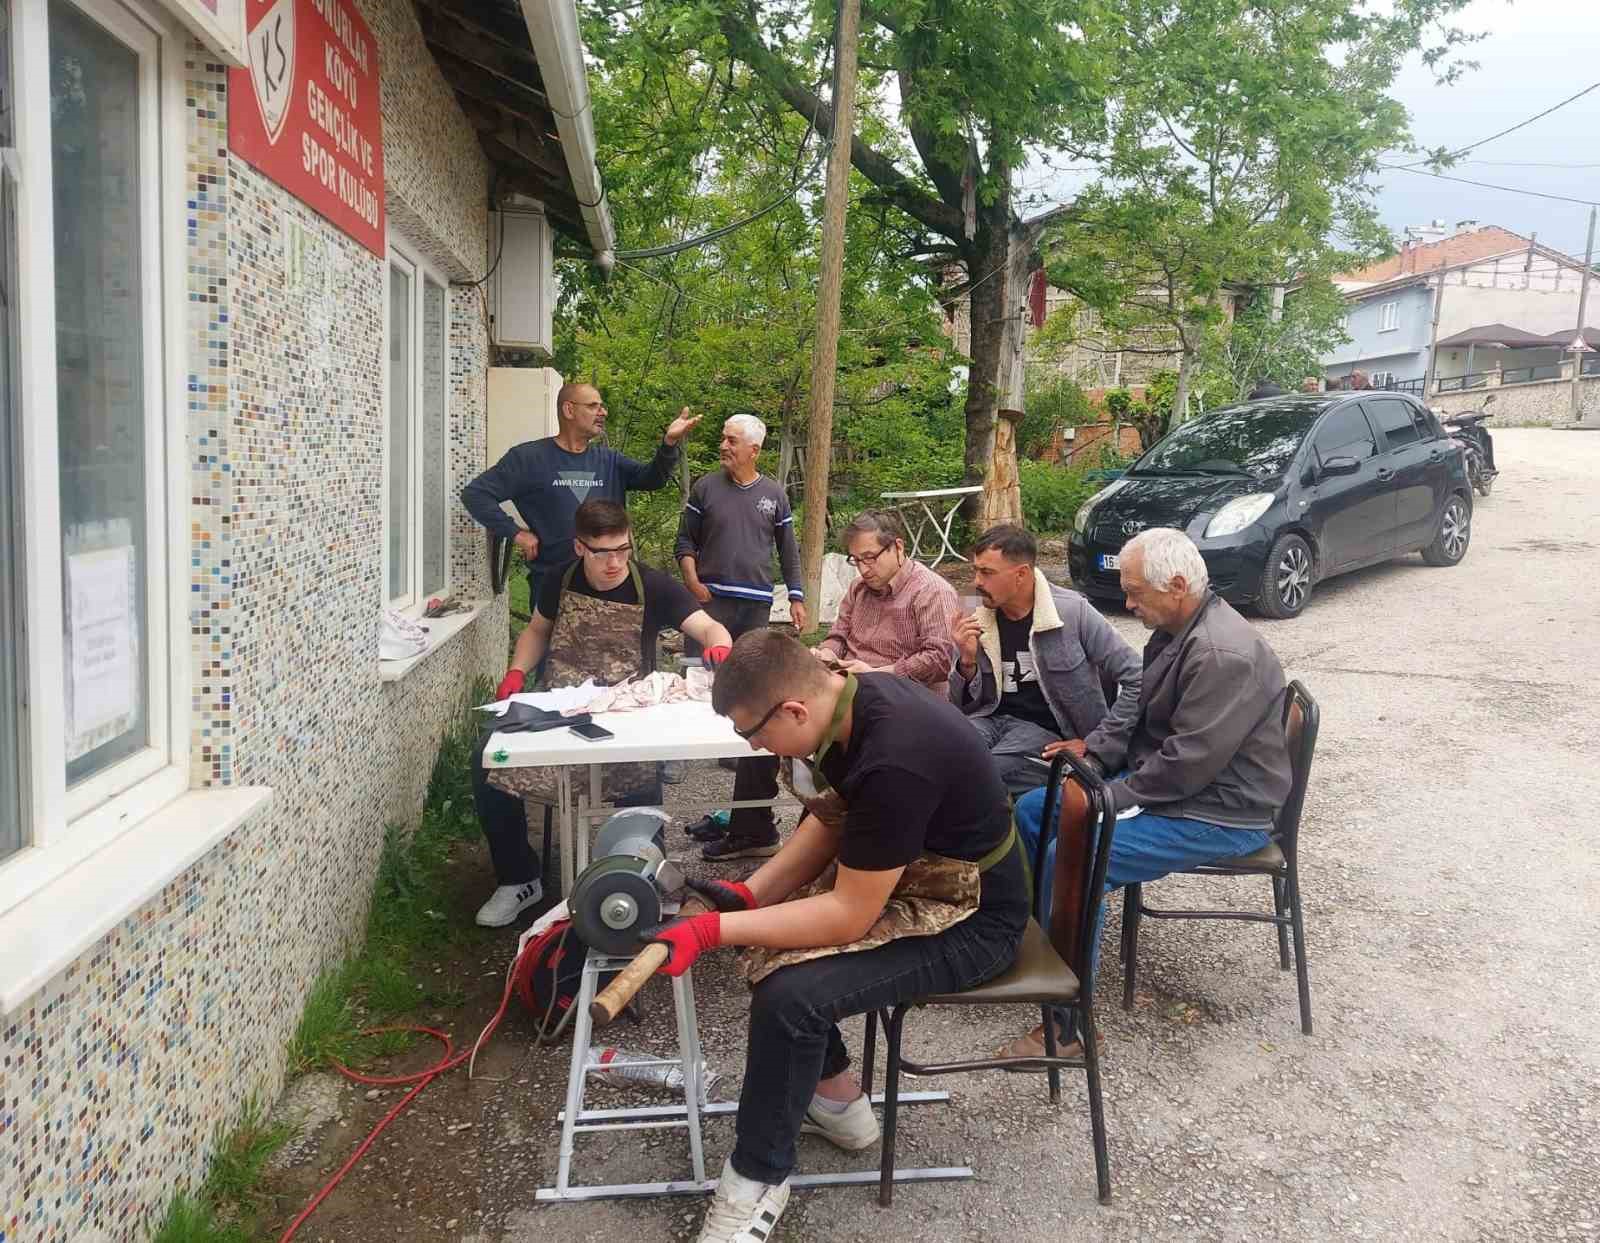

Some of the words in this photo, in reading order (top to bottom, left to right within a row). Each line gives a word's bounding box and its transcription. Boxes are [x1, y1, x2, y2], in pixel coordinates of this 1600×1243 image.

[325, 40, 357, 109] KÖYÜ
[307, 80, 359, 162] GENÇLİK
[360, 134, 373, 177] VE
[302, 131, 336, 194] SPOR
[338, 164, 378, 229] KULÜBÜ
[552, 479, 604, 487] AWAKENING
